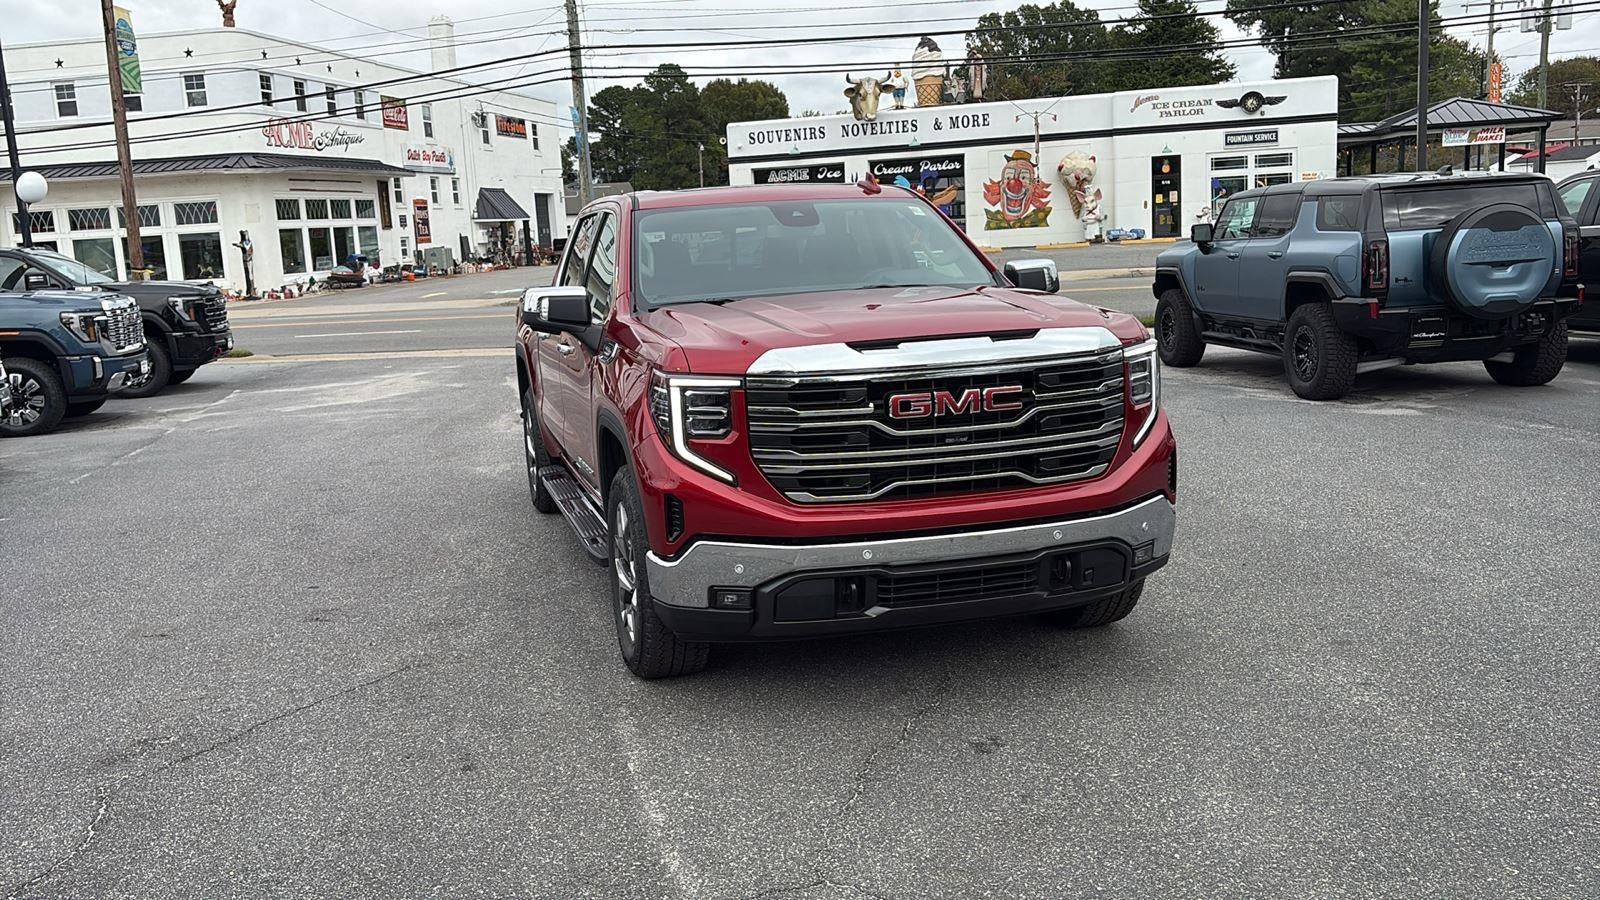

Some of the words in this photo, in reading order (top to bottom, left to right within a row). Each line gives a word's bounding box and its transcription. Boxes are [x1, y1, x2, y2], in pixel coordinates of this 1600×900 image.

[1152, 102, 1170, 110] ICE
[1173, 99, 1213, 109] CREAM
[1159, 108, 1205, 118] PARLOR
[261, 118, 315, 149] ACME
[748, 126, 826, 145] SOUVENIRS
[840, 119, 919, 138] NOVELTIES
[932, 117, 943, 131] &
[949, 113, 990, 130] MORE
[1226, 133, 1253, 143] FOUNTAIN
[1254, 132, 1277, 142] SERVICE
[422, 150, 431, 164] Boy
[768, 168, 810, 182] ACME
[816, 167, 842, 180] Ice
[874, 163, 914, 176] Cream
[919, 160, 962, 173] Parlor
[889, 385, 1023, 419] GMC
